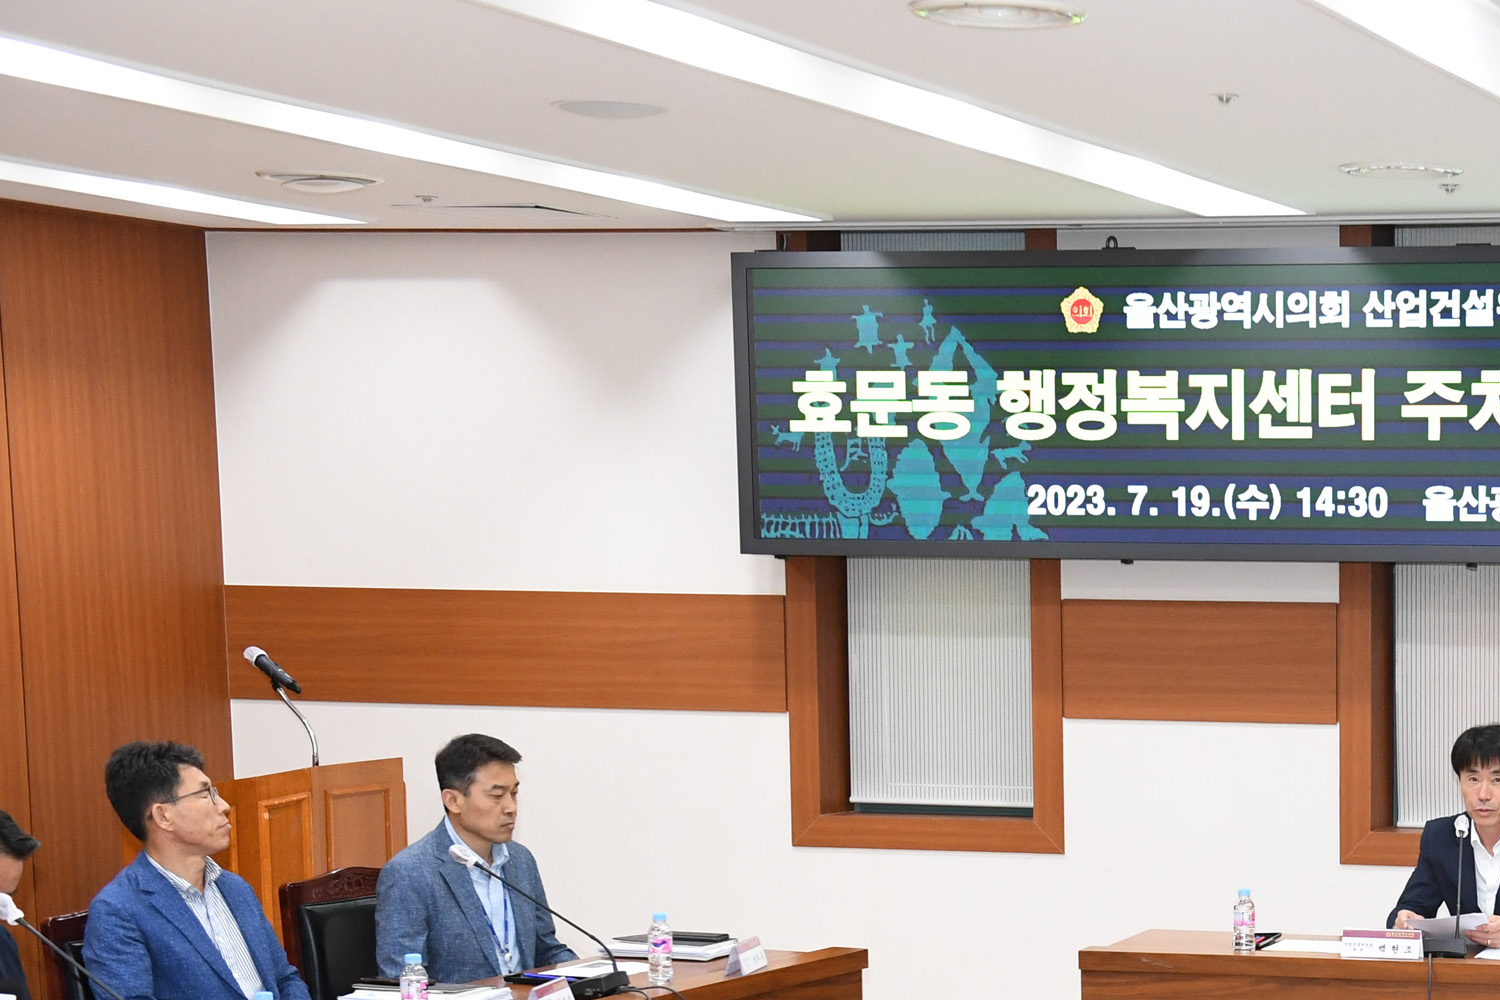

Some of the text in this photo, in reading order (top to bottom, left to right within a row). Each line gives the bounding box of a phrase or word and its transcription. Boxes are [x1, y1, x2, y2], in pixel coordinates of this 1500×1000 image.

[1122, 289, 1350, 330] 울산광역시의회
[789, 369, 975, 441] 효문동
[996, 368, 1376, 441] 행정복지센터
[1027, 483, 1116, 517] 2023.
[1127, 485, 1159, 517] 7.
[1171, 483, 1282, 521] 19.(수)
[1296, 485, 1389, 519] 14:30
